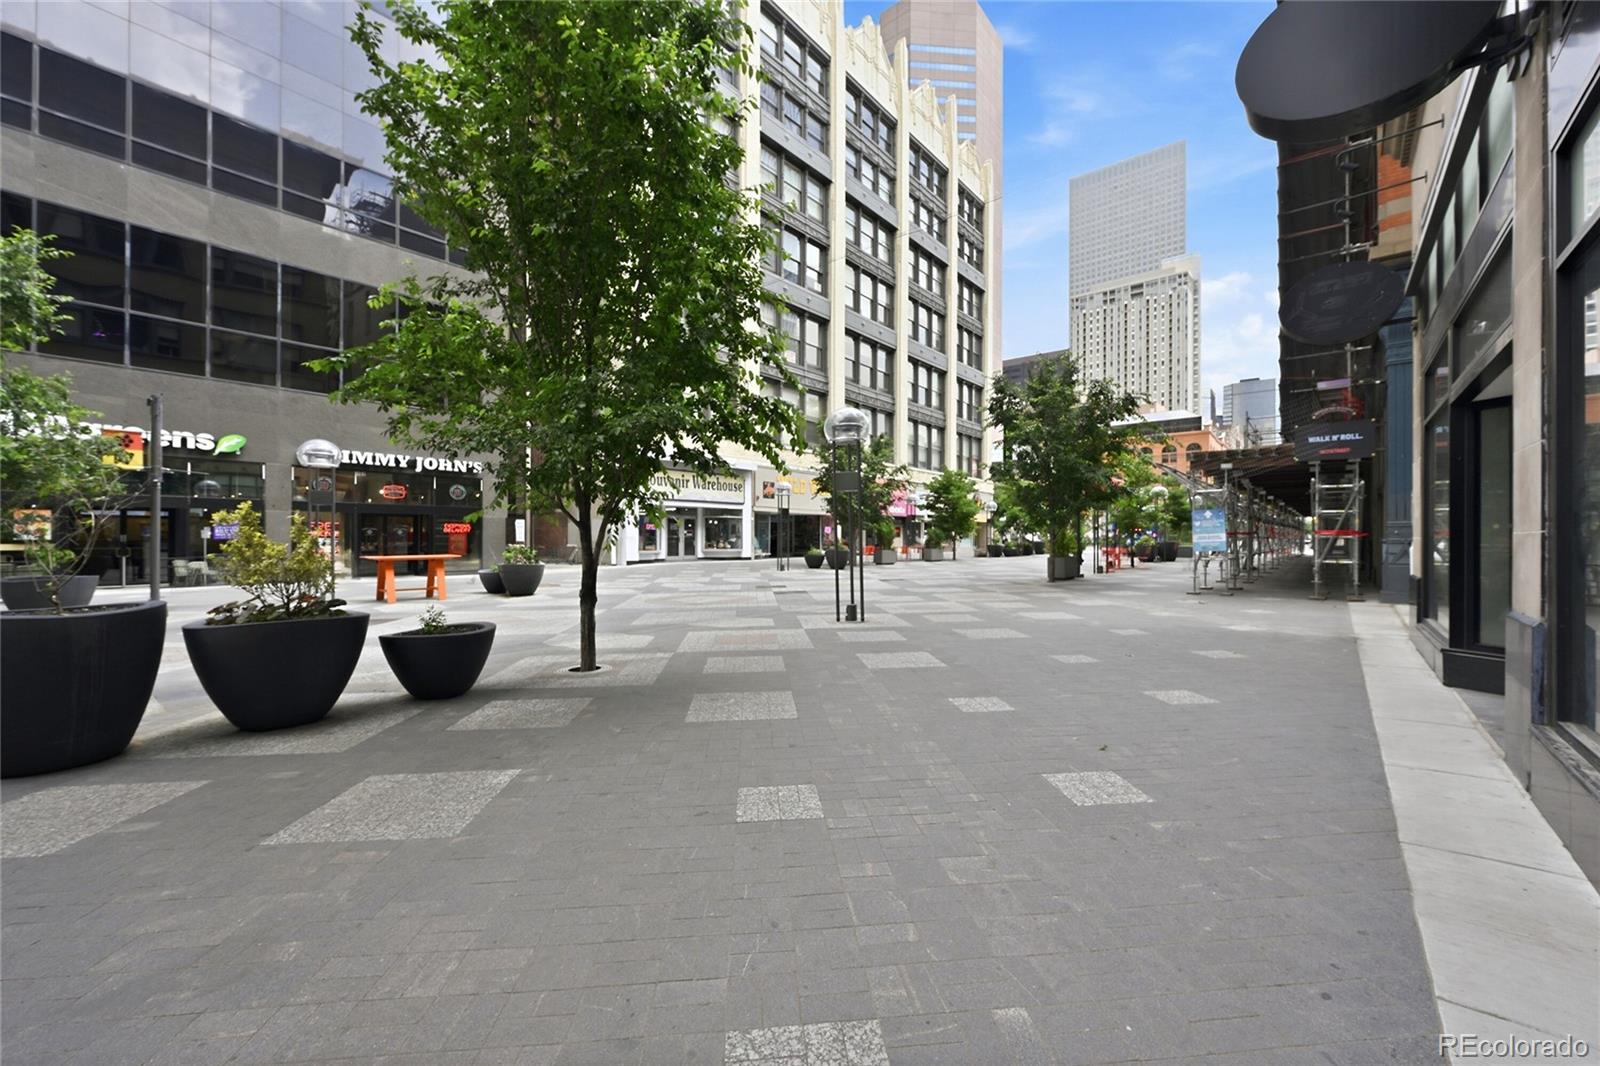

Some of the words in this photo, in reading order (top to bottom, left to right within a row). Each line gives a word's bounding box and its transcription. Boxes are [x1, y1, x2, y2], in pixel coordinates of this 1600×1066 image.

[1307, 435, 1330, 443] WALK
[341, 450, 410, 468] IMMY
[415, 456, 483, 474] JOHN'S
